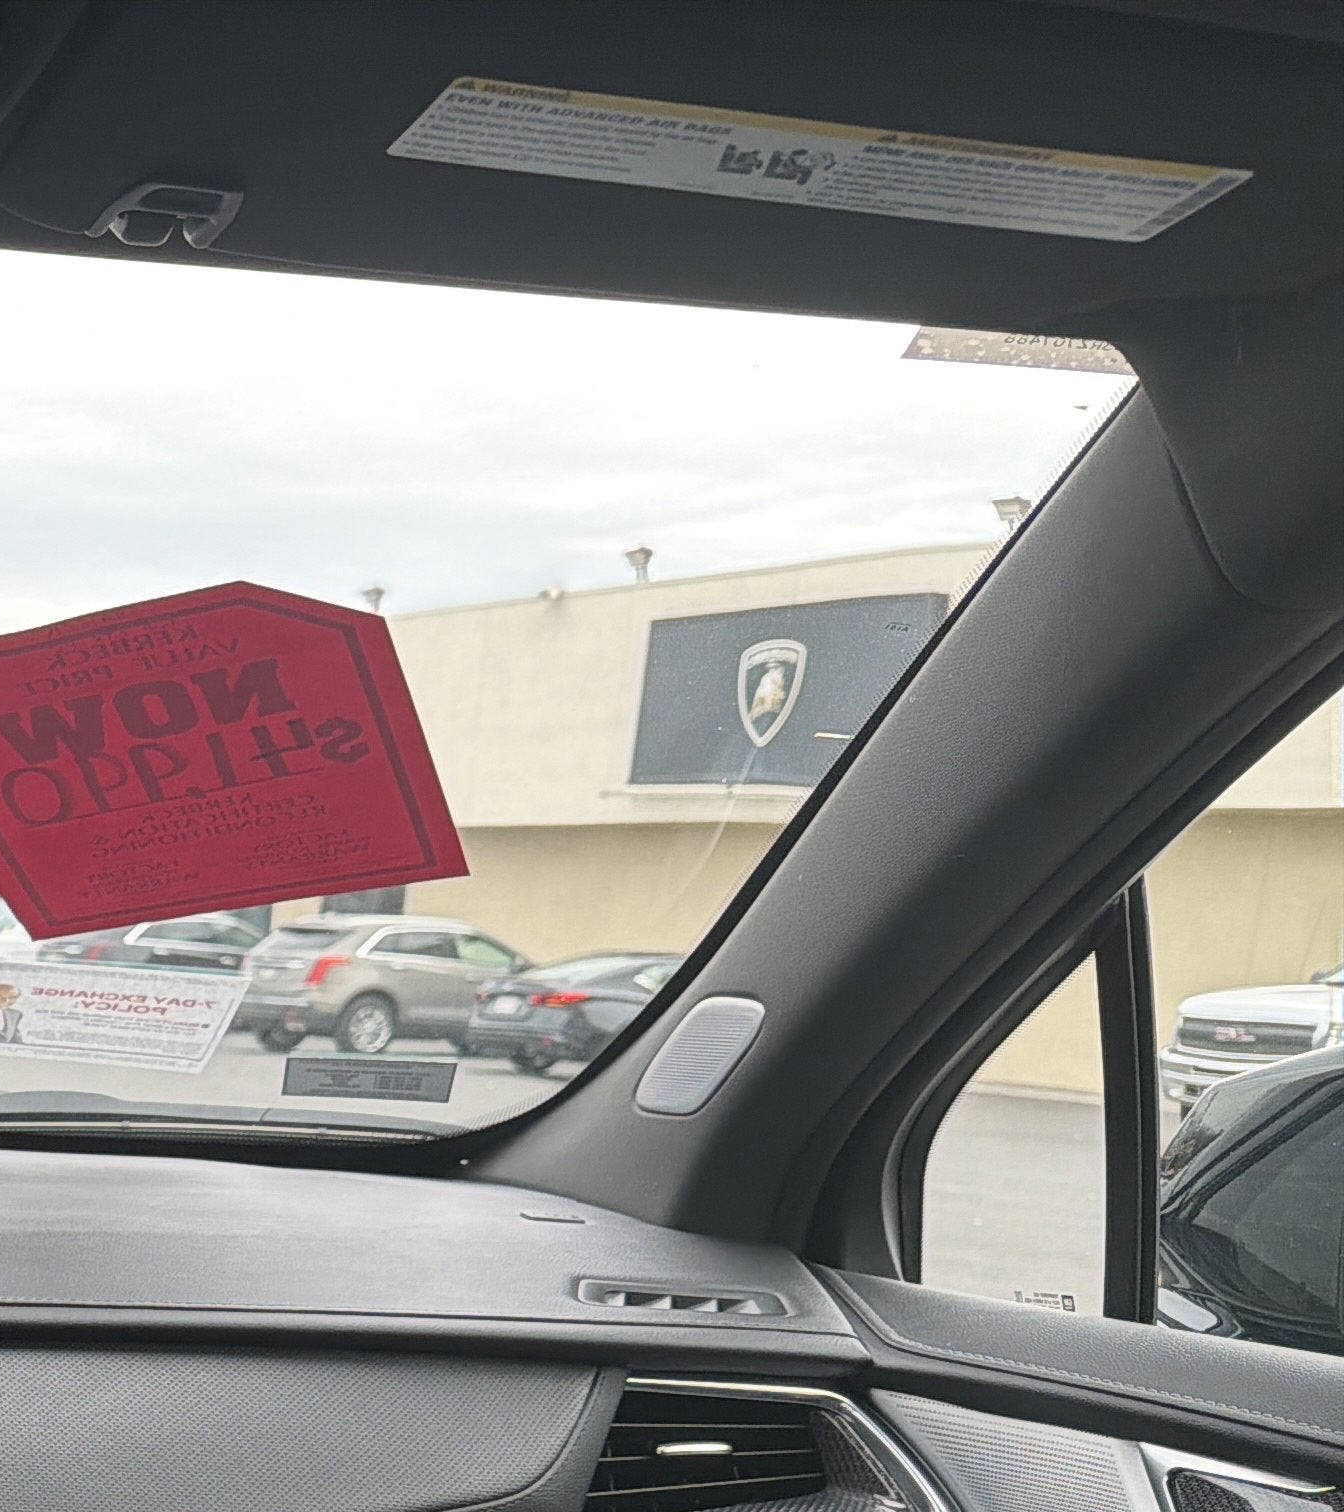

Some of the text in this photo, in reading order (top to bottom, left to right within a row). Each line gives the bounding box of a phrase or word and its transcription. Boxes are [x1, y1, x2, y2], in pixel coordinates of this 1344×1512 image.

[444, 92, 733, 136] EVEN WITH ADVANCED AIR BAGS
